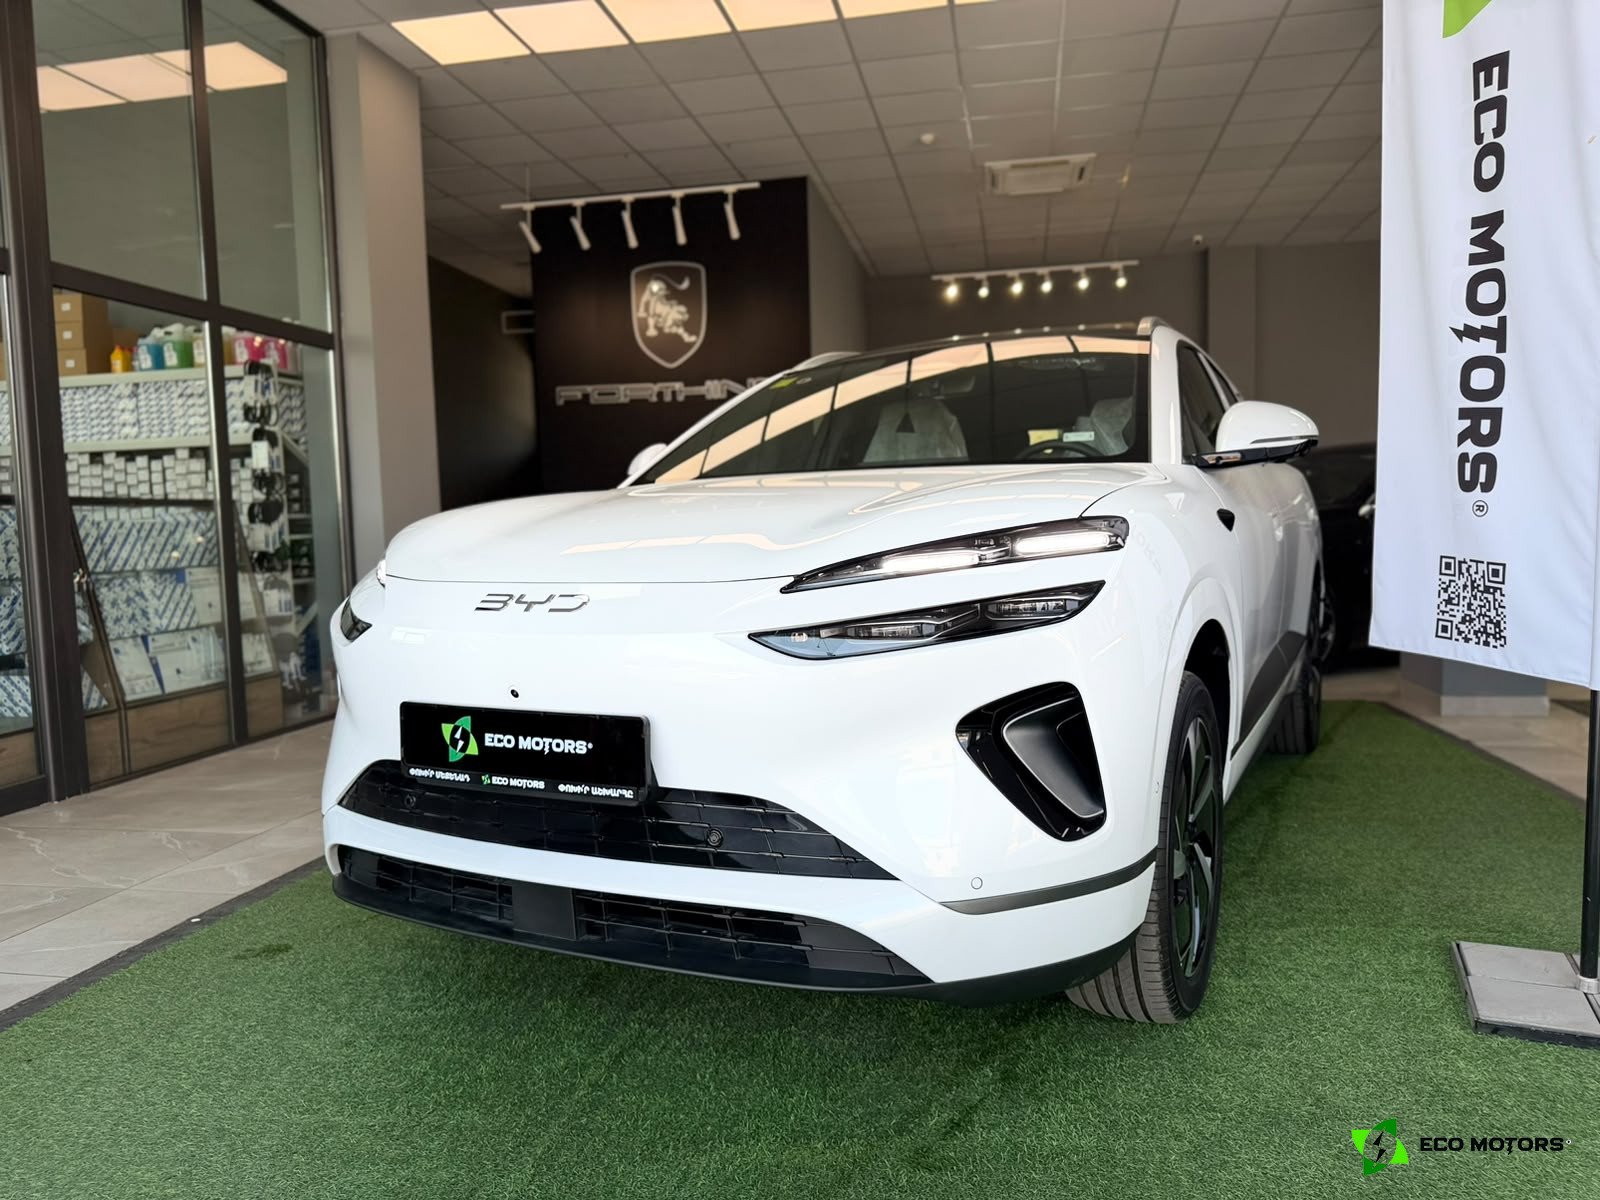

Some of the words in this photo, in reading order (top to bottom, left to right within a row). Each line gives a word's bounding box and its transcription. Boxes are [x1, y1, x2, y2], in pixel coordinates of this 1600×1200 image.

[1472, 50, 1510, 193] ECO
[555, 377, 769, 406] FORTHIN
[474, 593, 590, 613] BYD
[484, 732, 516, 748] ECO
[491, 775, 509, 786] ECO
[509, 777, 546, 790] MOTORS
